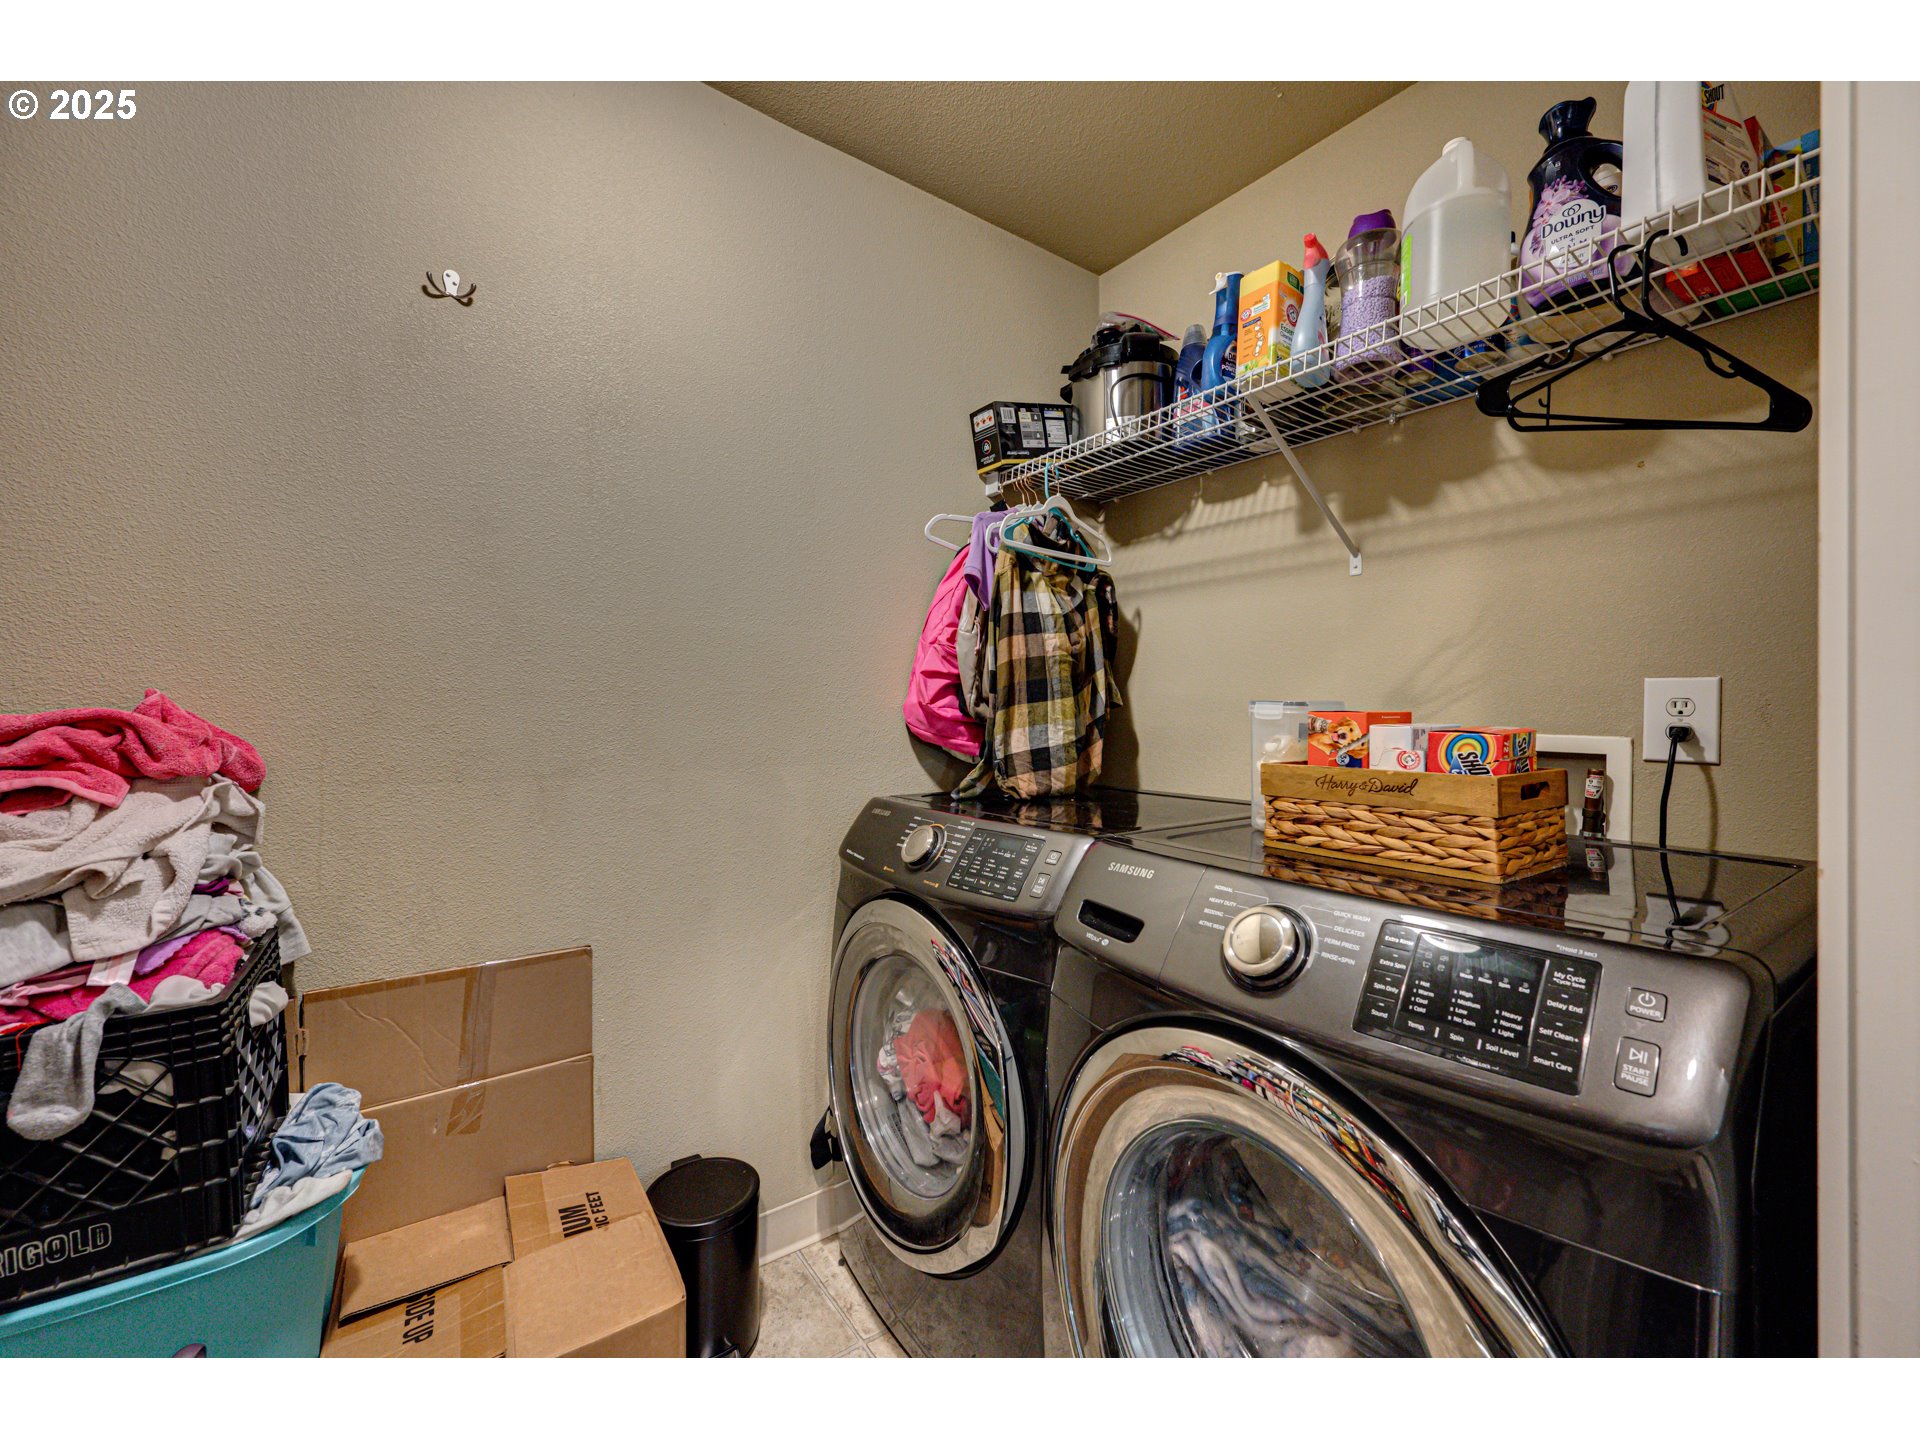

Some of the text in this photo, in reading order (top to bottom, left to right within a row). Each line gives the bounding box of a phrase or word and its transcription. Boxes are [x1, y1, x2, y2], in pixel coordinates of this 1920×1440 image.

[1542, 206, 1605, 239] Downy
[1551, 232, 1574, 245] ULTRA
[1575, 225, 1595, 235] SOFT
[1457, 751, 1491, 775] SHO
[1315, 773, 1357, 797] Harry
[1368, 777, 1419, 797] David
[1108, 862, 1155, 879] SAMSUNG
[1333, 910, 1371, 924] QUICK WASH
[1333, 925, 1366, 938] DELICATES
[1323, 937, 1361, 952] PERM PRESS
[1379, 958, 1407, 971] Extra Spin
[1553, 970, 1587, 985] My Cycle
[1373, 981, 1400, 995] Spin Only
[1413, 1005, 1427, 1014] Cold
[1457, 998, 1481, 1010] Medium
[1546, 999, 1584, 1015] Delay End
[1629, 1004, 1662, 1018] POWER
[1371, 1008, 1389, 1020] Sound
[1455, 1007, 1468, 1016] Low
[1501, 1010, 1523, 1022] Heavy
[1462, 1018, 1477, 1028] Spin
[1499, 1019, 1524, 1032] Normal
[1449, 1032, 1465, 1043] Spin
[1497, 1028, 1515, 1040] Light
[1538, 1026, 1553, 1037] Self
[1485, 1043, 1520, 1059] Soil Level
[1533, 1055, 1574, 1073] Smart Care
[1622, 1063, 1651, 1077] START
[1620, 1072, 1650, 1087] PAUSE
[585, 1191, 605, 1215] FEET
[0, 1222, 112, 1279] IGOLD
[402, 1319, 434, 1345] UP
